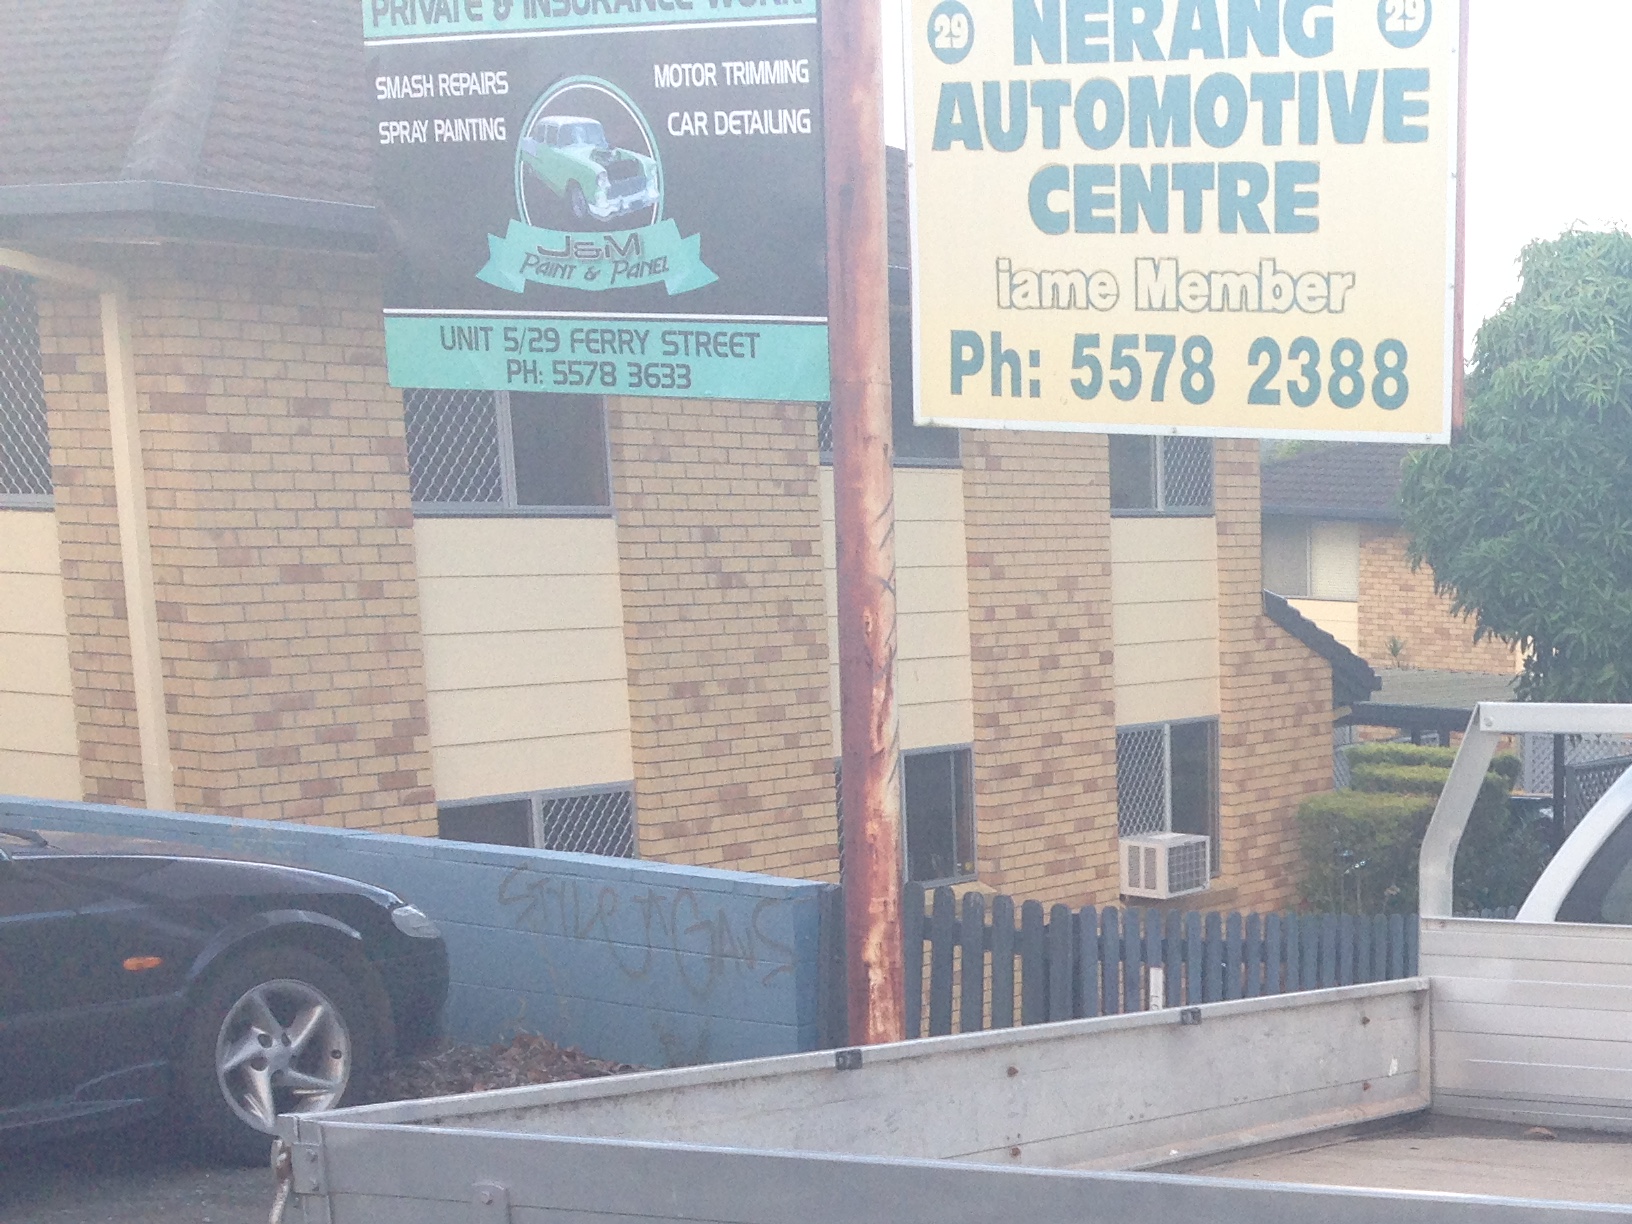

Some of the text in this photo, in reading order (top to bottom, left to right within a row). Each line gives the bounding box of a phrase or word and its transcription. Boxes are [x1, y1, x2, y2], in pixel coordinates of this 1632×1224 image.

[372, 0, 484, 27] PRIVATE
[1385, 0, 1424, 32] 29
[933, 13, 969, 48] 29
[1012, 0, 1334, 66] NERANG
[375, 70, 509, 100] SMASH REPAIRS
[654, 58, 809, 88] MOTOR TRIMMING
[667, 108, 812, 137] CAR DETAILING
[931, 67, 1430, 152] AUTOMOTIVE
[378, 117, 507, 145] SPRAY PAINTING
[1027, 160, 1321, 235] CENTRE
[536, 232, 645, 260] J&M
[583, 265, 601, 282] &
[996, 257, 1356, 313] iame Member
[440, 325, 760, 358] UNIT 5/29 FERRY STREET
[506, 359, 692, 389] PH: 5578 3633
[949, 329, 1409, 410] Ph: 5578 2388
